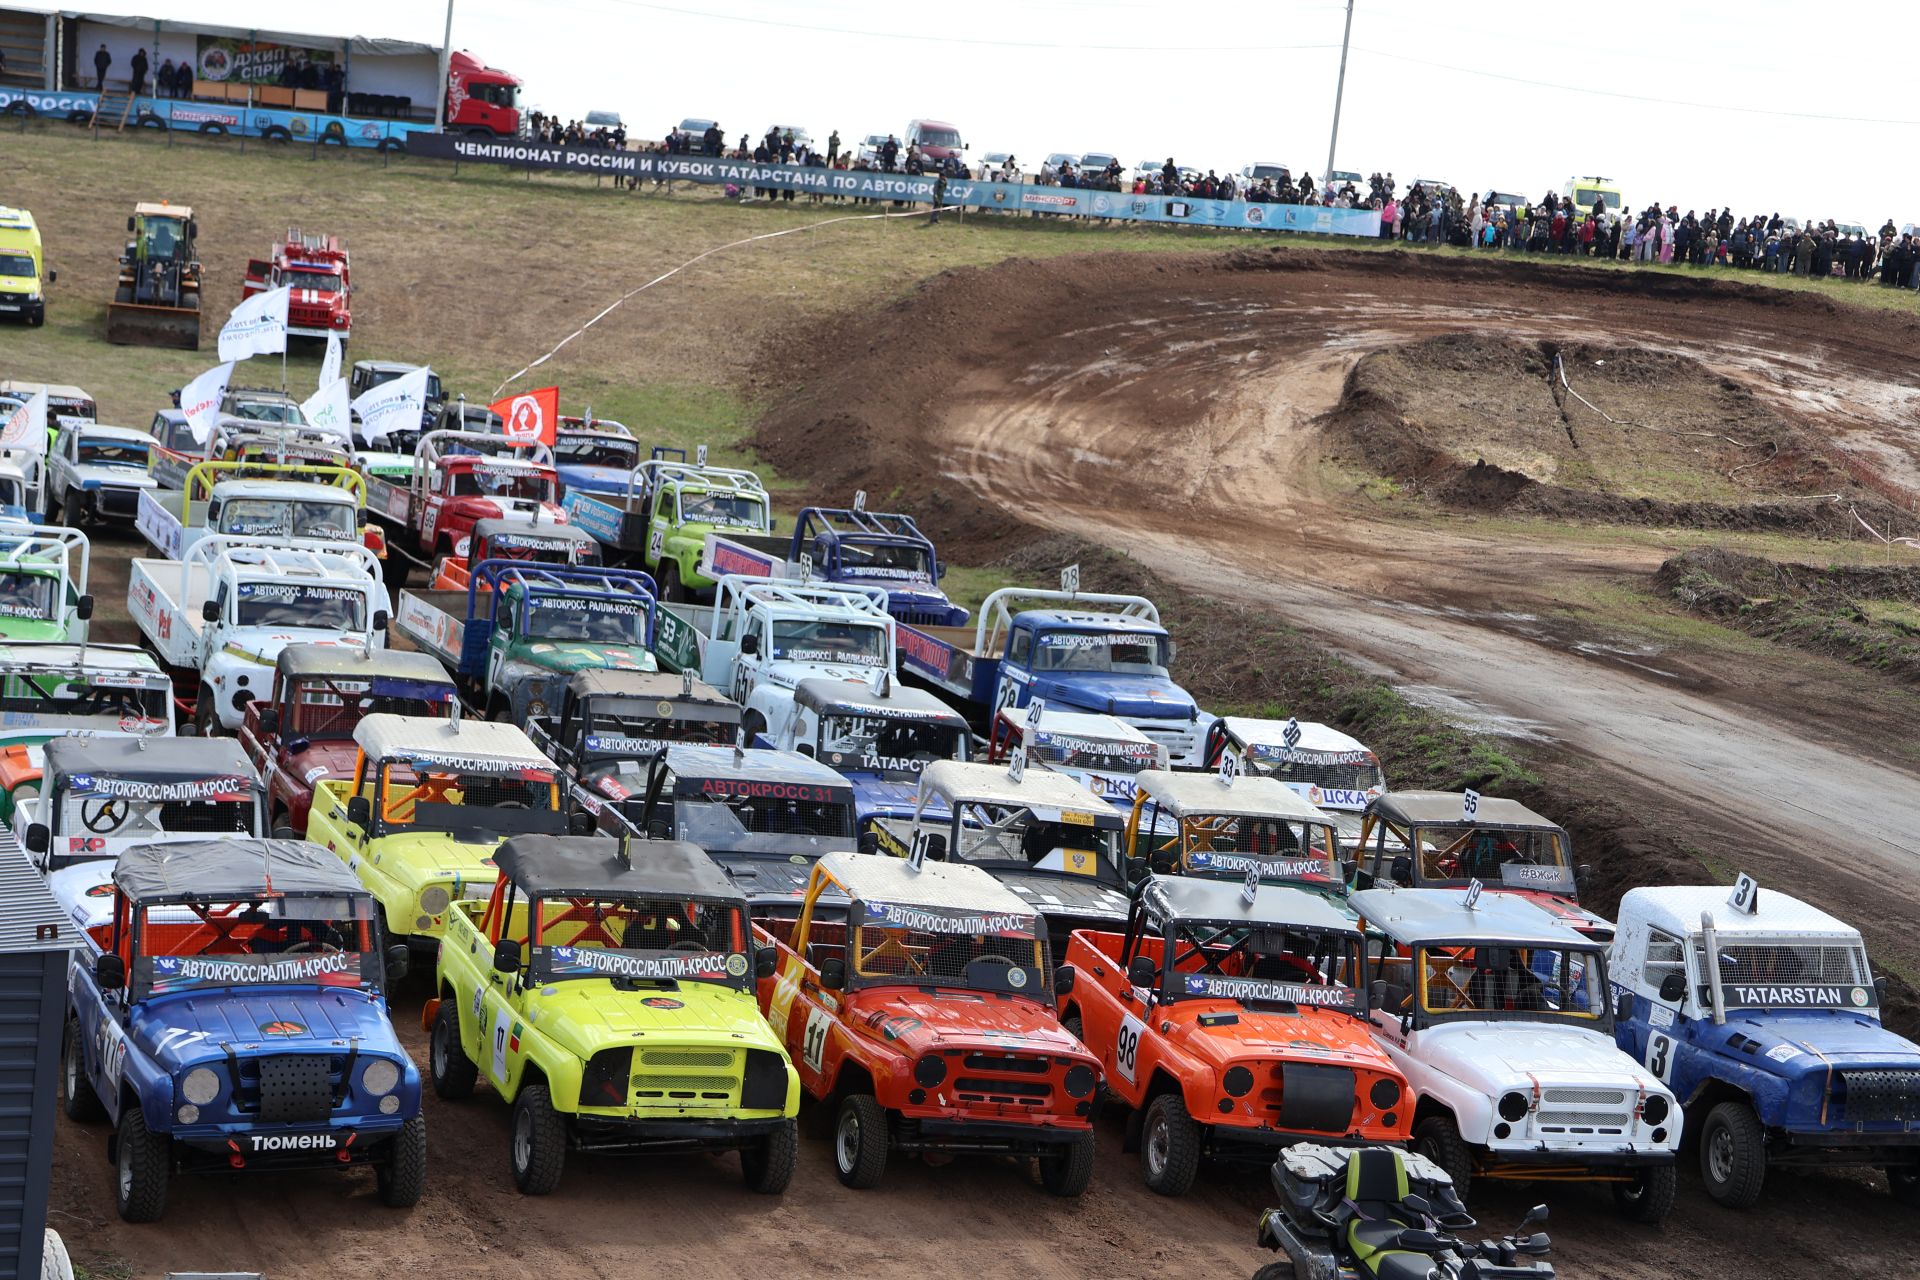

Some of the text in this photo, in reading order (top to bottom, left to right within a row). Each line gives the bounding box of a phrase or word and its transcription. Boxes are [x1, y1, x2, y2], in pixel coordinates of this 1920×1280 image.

[454, 141, 561, 164] ЧЕМПИОНАТ
[566, 152, 636, 169] РОССИИ
[641, 160, 652, 171] И
[657, 160, 714, 177] КУБОК
[718, 165, 828, 187] ТАТАРСТАНА
[833, 176, 857, 189] ПО
[707, 490, 735, 500] ИРБИТ
[425, 511, 435, 529] 99
[651, 532, 662, 552] 24
[801, 559, 812, 578] 65
[1062, 567, 1078, 589] 28
[254, 585, 301, 597] АВТОКРОСС
[542, 599, 587, 610] АВТОКРОСС
[589, 601, 638, 616] РАЛЛИ-КРОСС
[663, 618, 677, 643] 53
[683, 671, 692, 692] 63
[735, 662, 750, 706] 65
[996, 684, 1017, 712] 28
[1027, 701, 1042, 724] 20
[1050, 735, 1150, 755] АВТОКРОСС/РАЛЛИ-КРОСС
[1268, 746, 1364, 765] АВТОКРОСС/РАЛЛИ-КРОСС
[860, 755, 930, 772] ТАТАРСТ
[1012, 753, 1023, 775] 30
[1223, 754, 1235, 778] 33
[94, 778, 240, 800] АВТОКРОСС/РАЛЛИ-КРОСС
[703, 779, 832, 802] АВТОКРОСС 31
[1106, 777, 1137, 796] ЦСК
[1323, 789, 1368, 805] ЦСКА
[1464, 792, 1478, 814] 55
[910, 828, 928, 869] 11
[1210, 854, 1321, 876] АВТОКРОСС/РАЛЛИ-КРОСС
[1246, 869, 1258, 893] 98
[1735, 877, 1750, 907] 3
[1466, 880, 1482, 906] 19
[886, 905, 1023, 934] АВТОКРОСС/РАЛЛИ-КРОСС
[181, 953, 348, 983] АВТОКРОСС/РАЛЛИ-КРОСС
[576, 953, 725, 978] АВТОКРОСС/РАЛЛИ-КРОСС
[1735, 987, 1842, 1005] TATARSTAN
[155, 1027, 211, 1056] 77
[808, 1022, 825, 1065] 11
[1118, 1025, 1137, 1071] 98
[1651, 1035, 1670, 1079] 3
